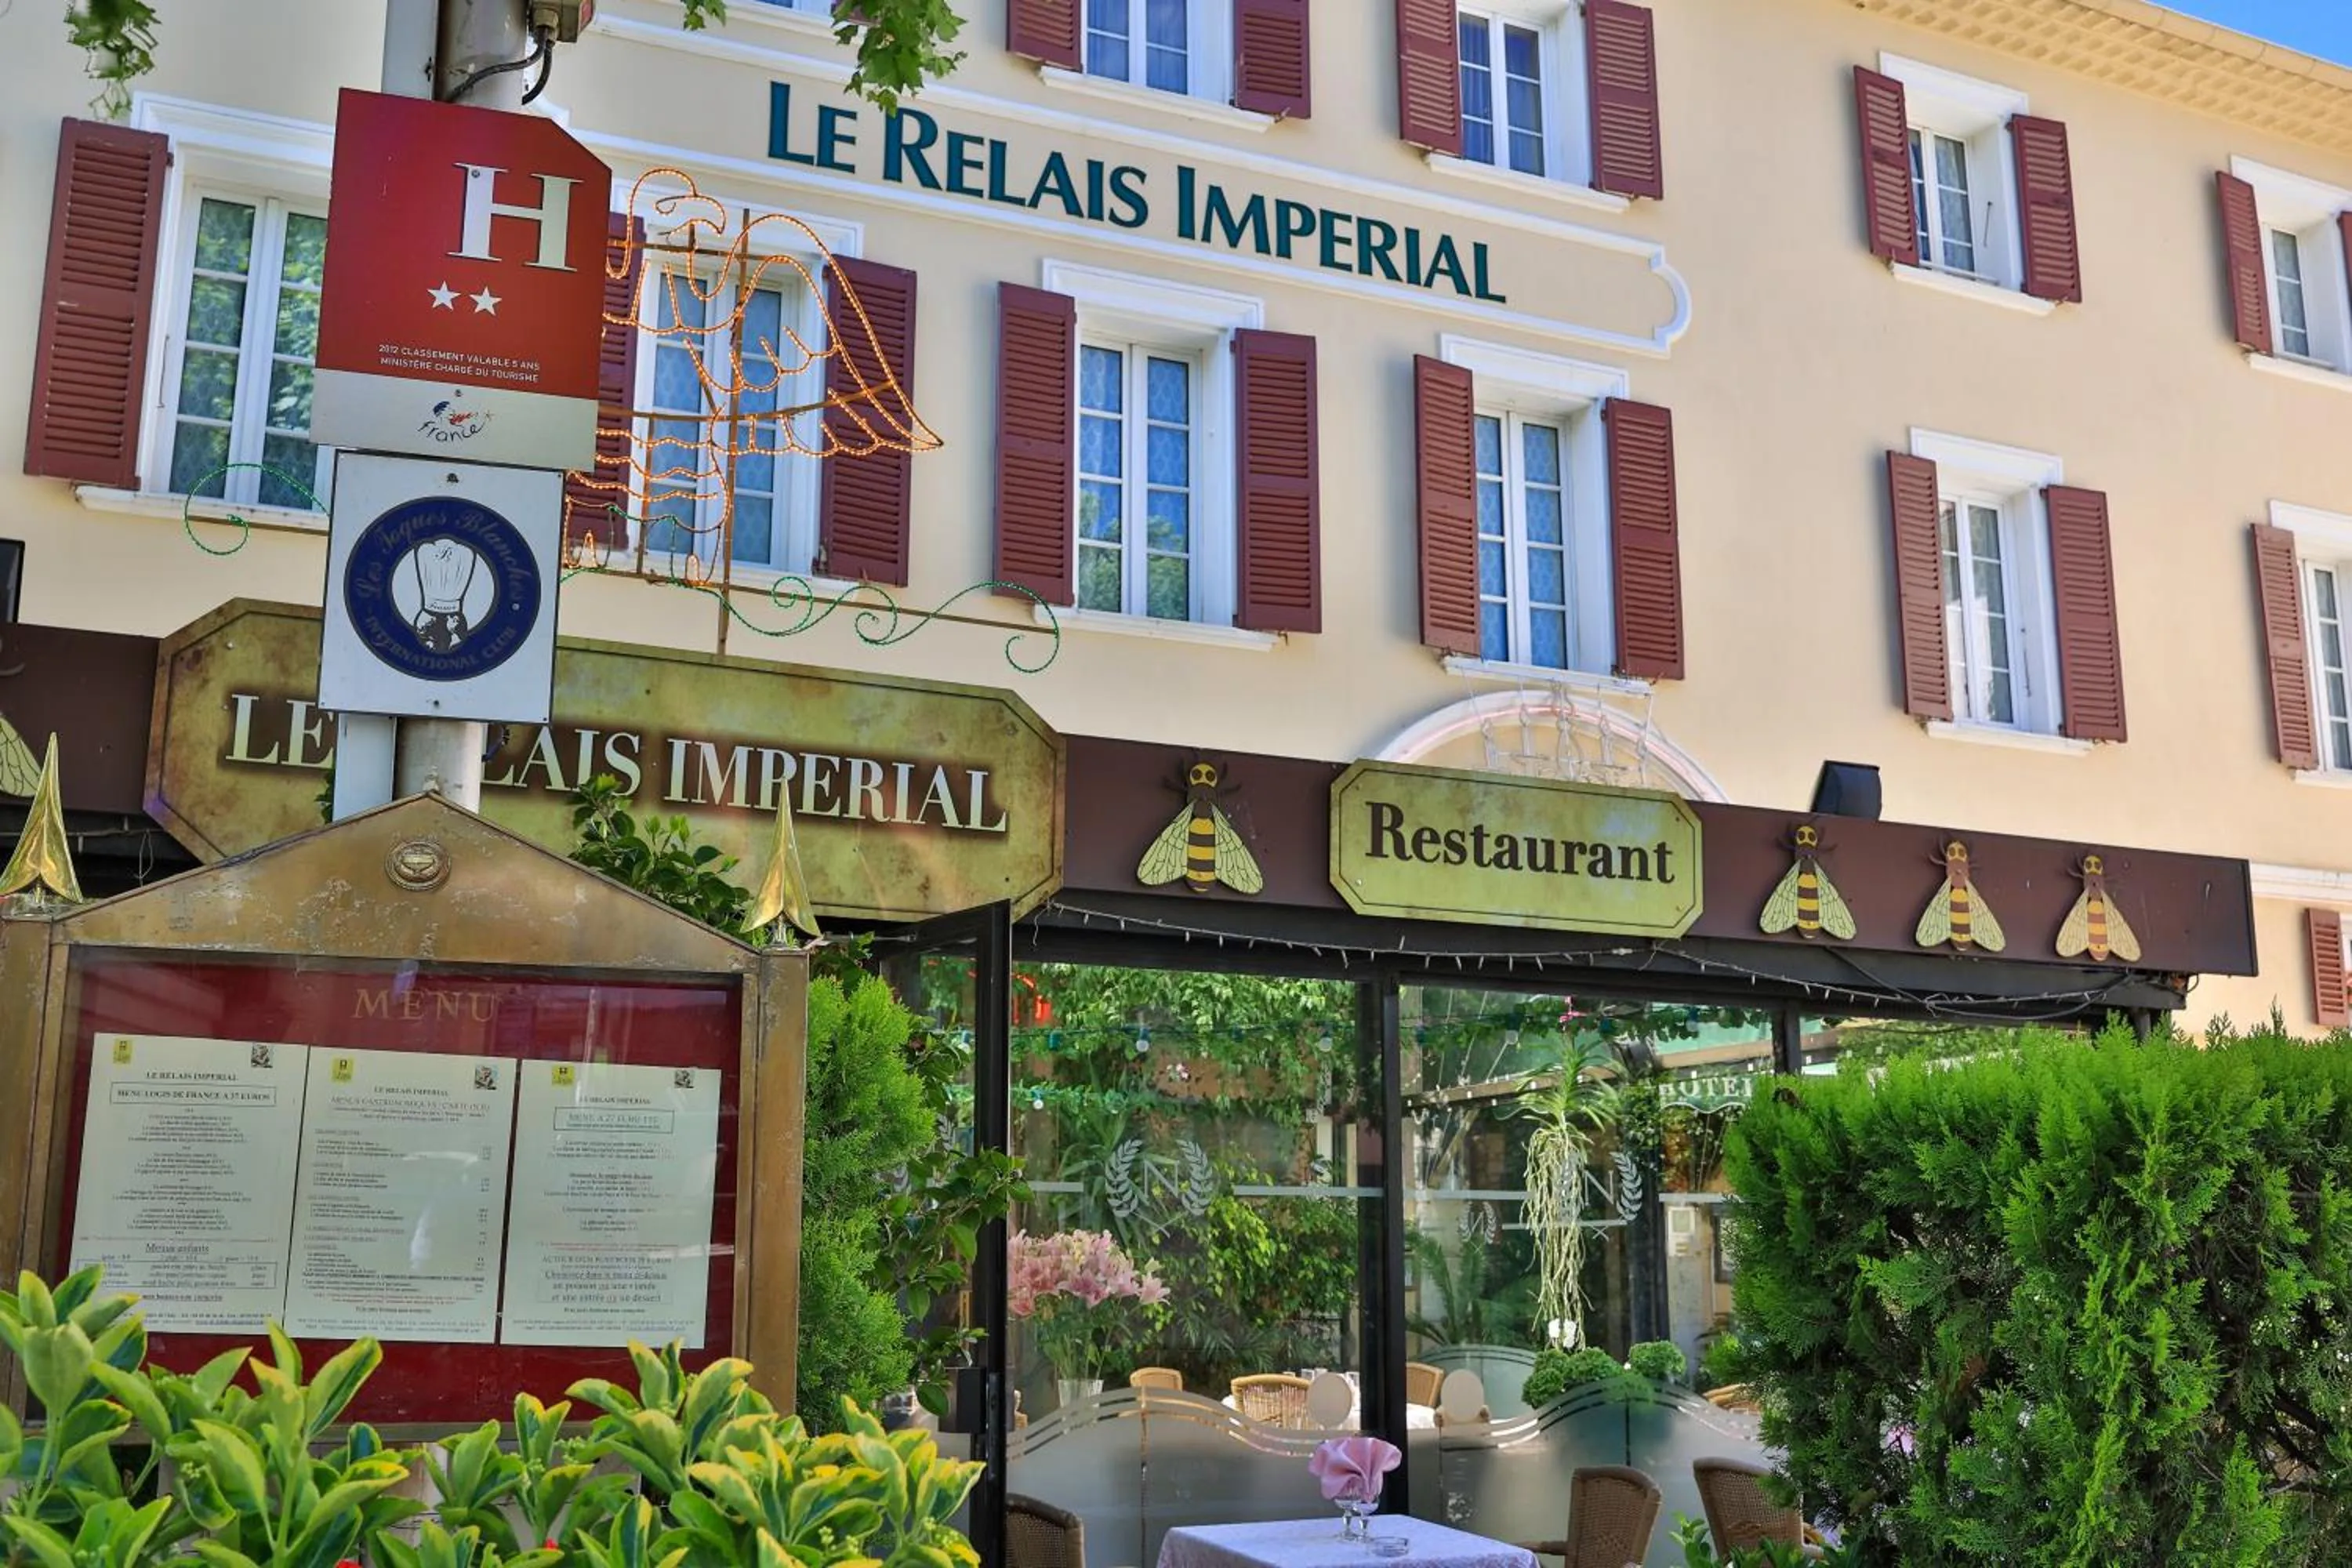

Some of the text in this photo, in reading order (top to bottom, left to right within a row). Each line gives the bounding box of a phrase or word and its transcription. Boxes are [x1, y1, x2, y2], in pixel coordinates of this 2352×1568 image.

[768, 81, 1507, 303] LE RELAIS IMPERIAL
[446, 162, 584, 273] H
[401, 347, 464, 361] CLASSEMENT
[466, 354, 511, 368] VALABLE
[520, 361, 540, 371] ANS
[476, 368, 488, 377] DU
[491, 370, 539, 383] TOURISME
[417, 419, 485, 443] France
[371, 511, 448, 553] Toques
[365, 615, 481, 670] INTERNATIONAL
[226, 694, 336, 769] LE
[664, 738, 1007, 833] IMPERIAL
[1364, 800, 1676, 884] Restaurant
[351, 989, 499, 1022] MENU
